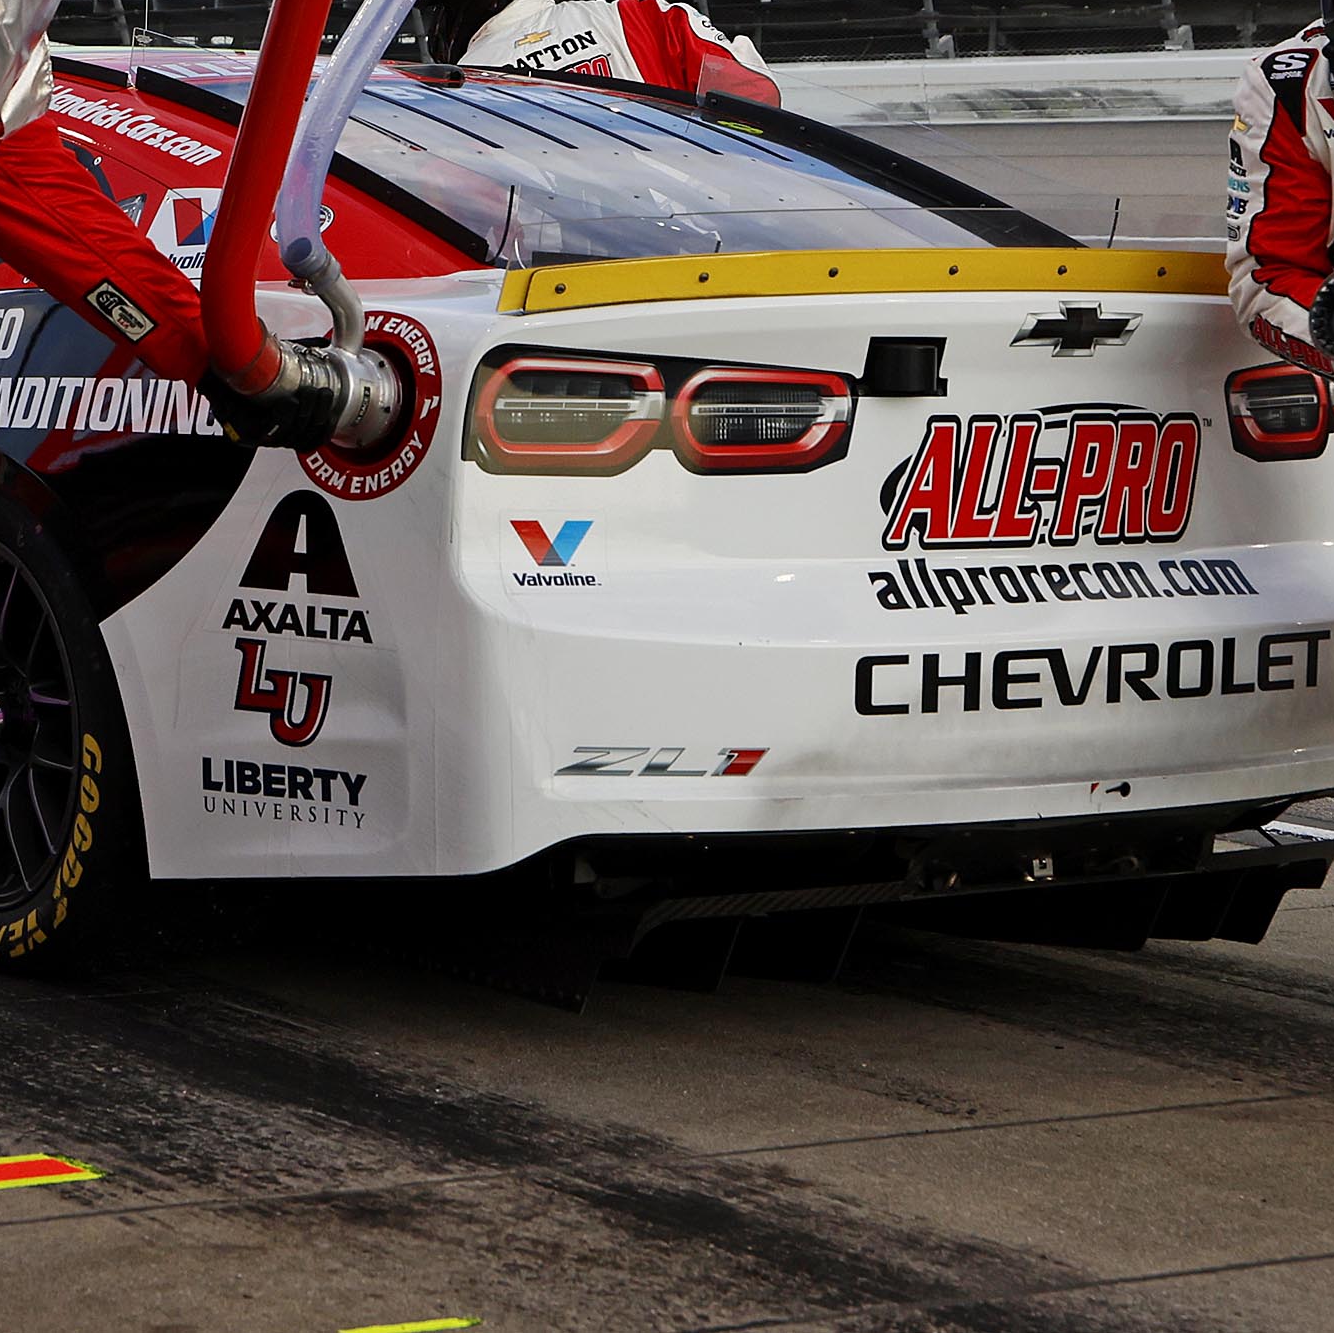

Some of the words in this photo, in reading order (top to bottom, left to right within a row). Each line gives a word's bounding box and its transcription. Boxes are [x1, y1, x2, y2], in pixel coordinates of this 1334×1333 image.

[503, 29, 598, 69] ATTON
[100, 292, 118, 310] sfi
[383, 318, 436, 377] ENERGY
[350, 430, 424, 495] ENERGY
[881, 411, 1202, 551] ALL-PRO
[513, 571, 601, 587] Valvoline
[868, 558, 1260, 614] allprorecon.com
[222, 597, 373, 644] AXALTA
[234, 637, 333, 748] LU
[854, 630, 1331, 716] CHEVROLET
[202, 756, 368, 807] LIBERTY
[553, 746, 771, 777] ZL1
[203, 796, 367, 829] UNIVERSITY
